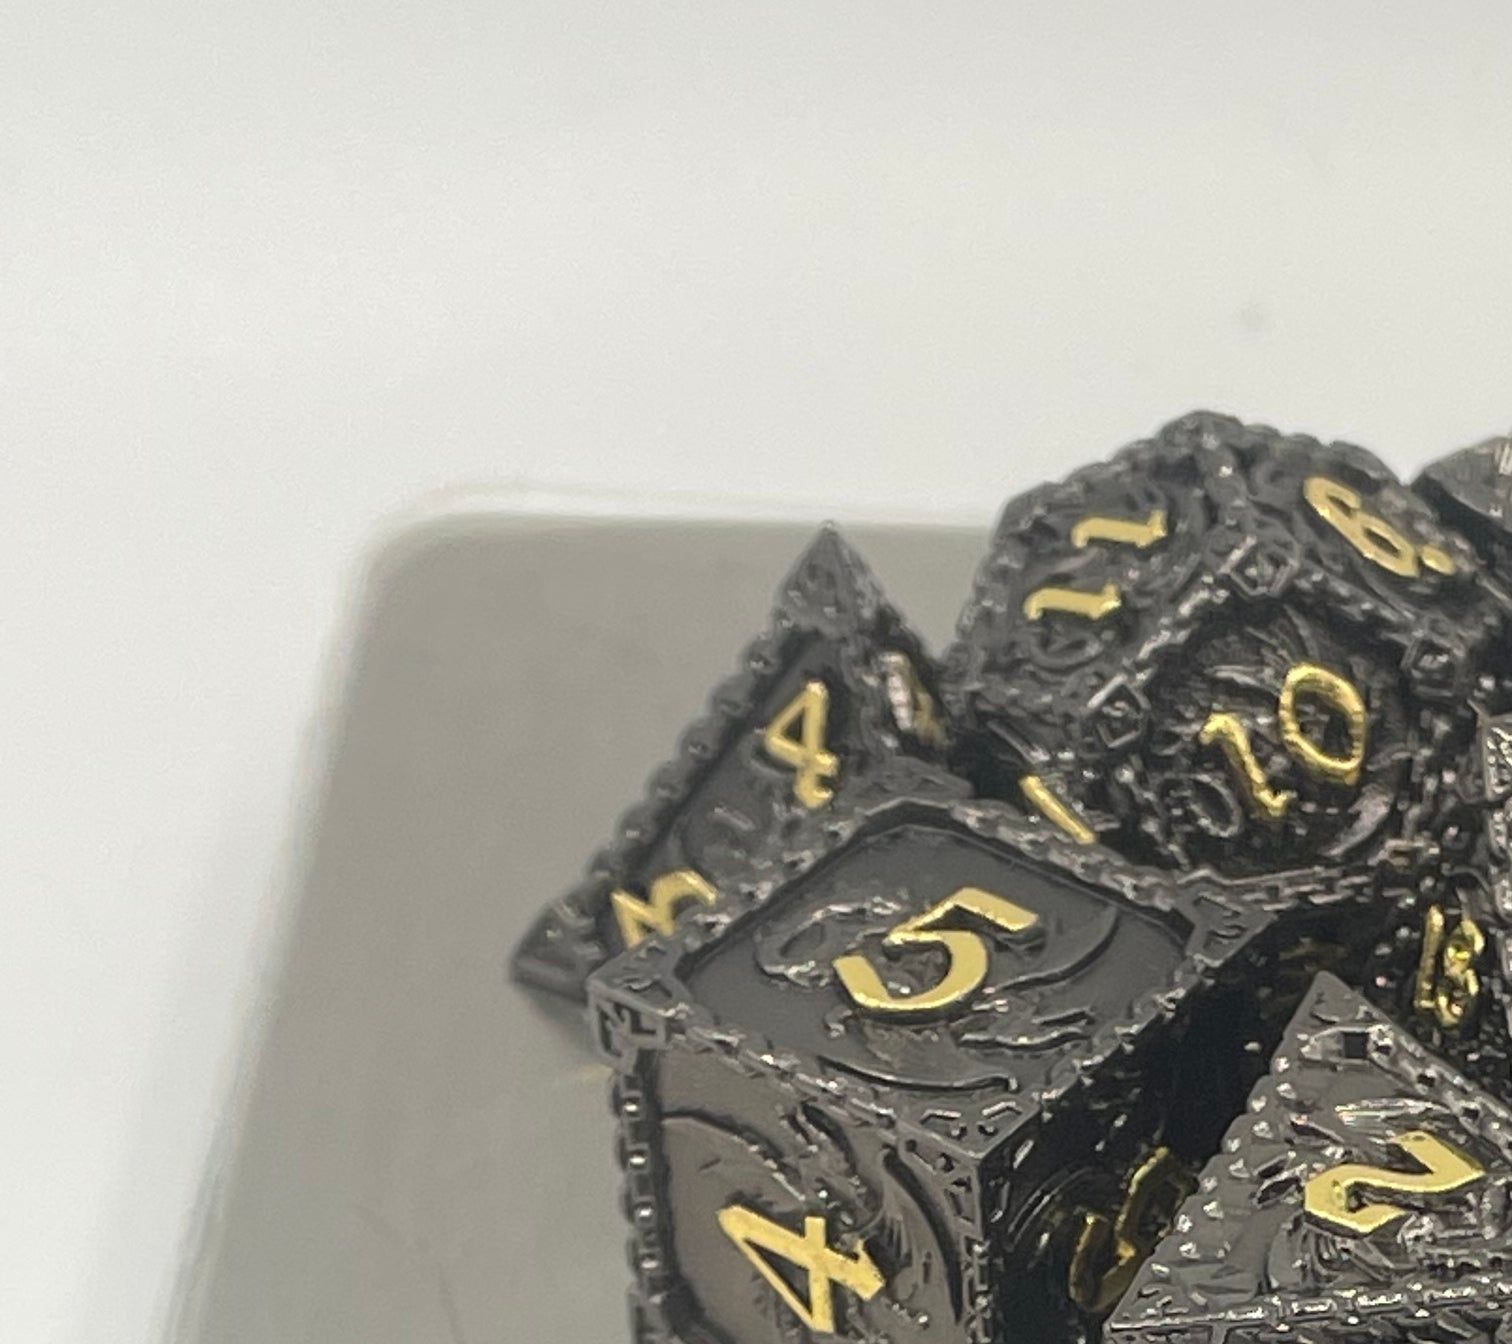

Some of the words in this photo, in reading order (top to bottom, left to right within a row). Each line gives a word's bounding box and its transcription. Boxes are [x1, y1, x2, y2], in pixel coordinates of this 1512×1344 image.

[1025, 508, 1167, 620] 11
[764, 680, 838, 808] 4
[1200, 661, 1368, 818] 10
[833, 886, 1038, 1012] 5
[1302, 1128, 1487, 1233] 2
[716, 1203, 887, 1334] 4
